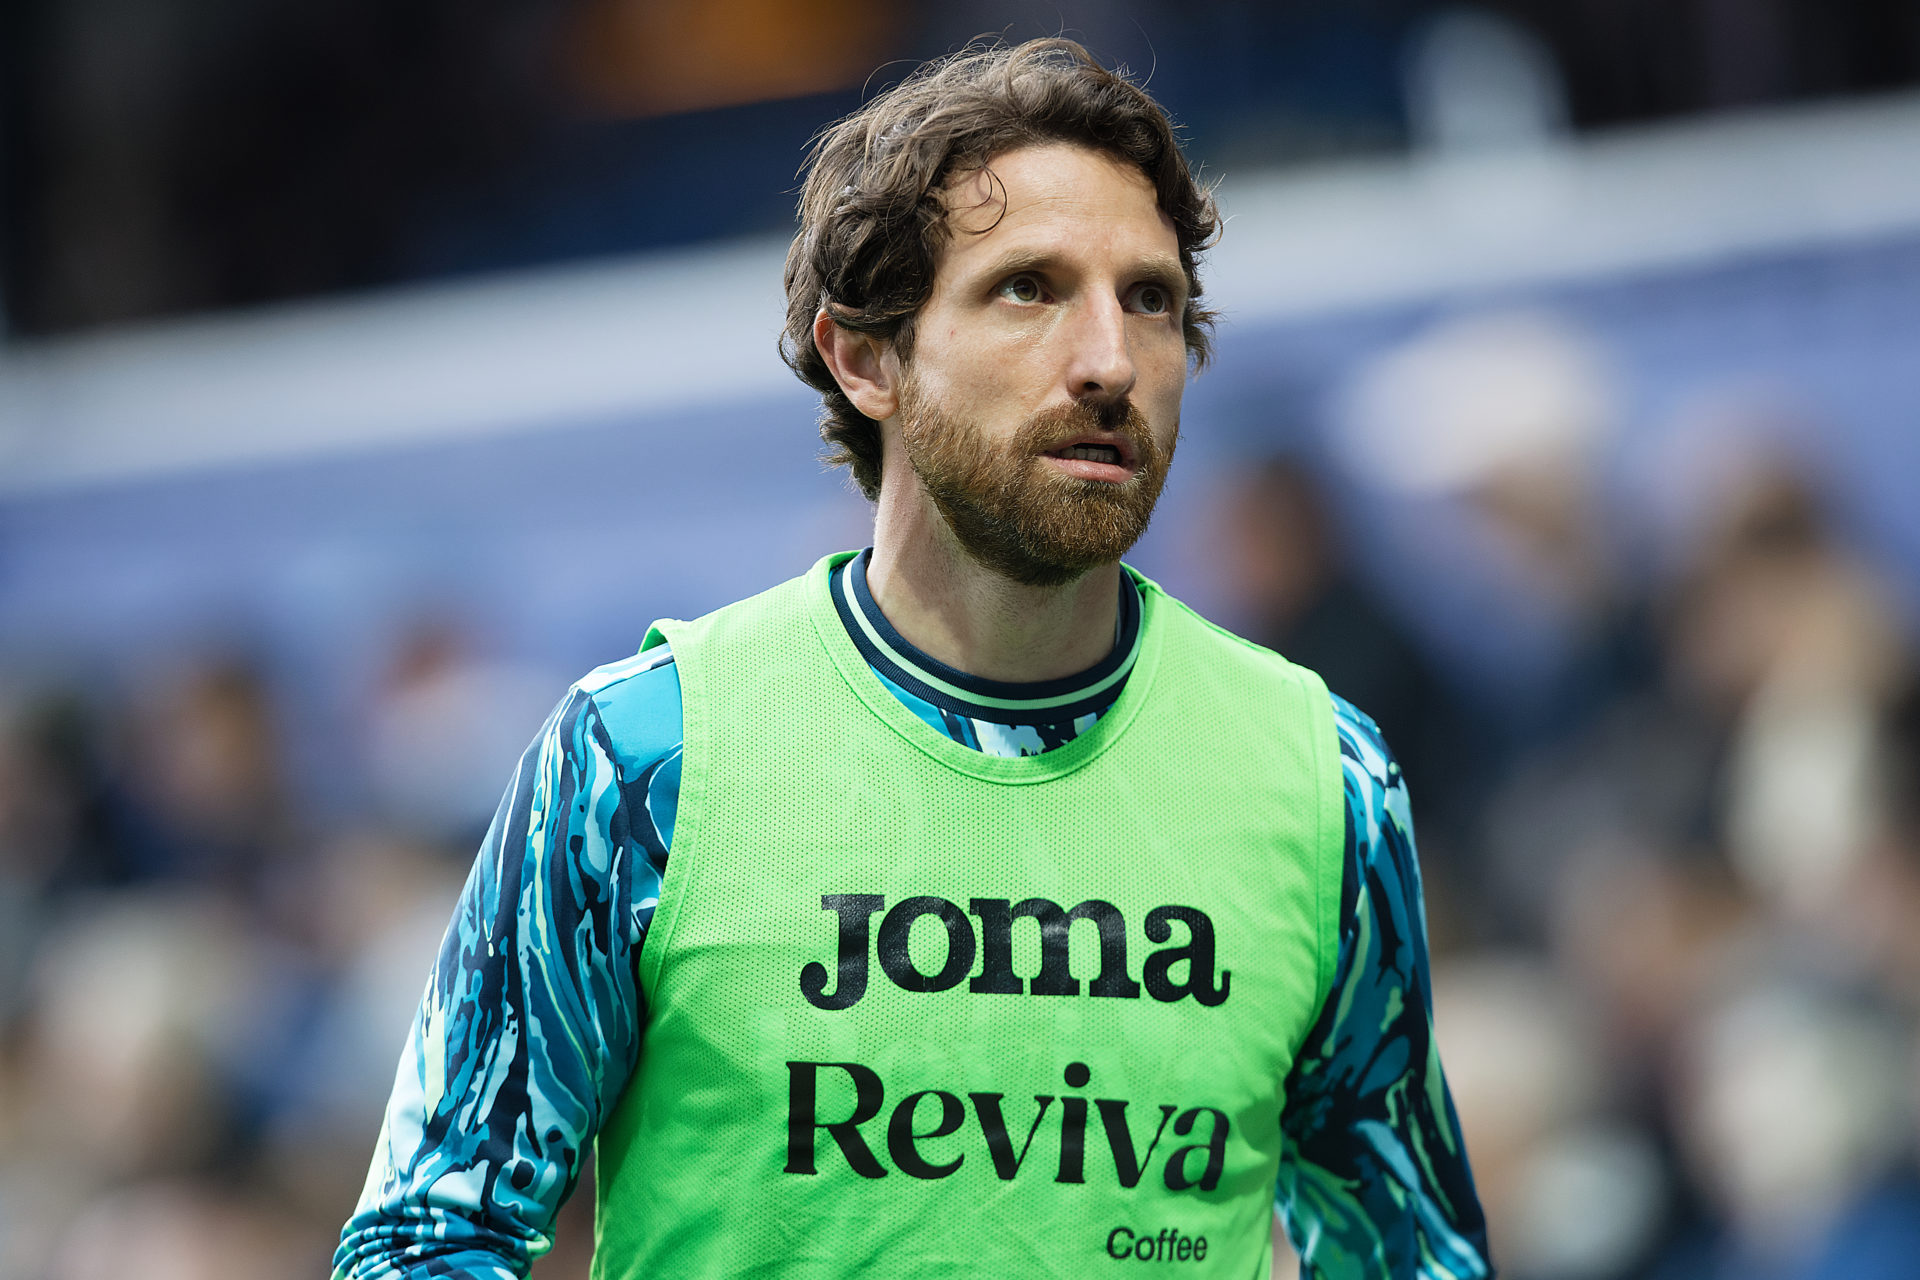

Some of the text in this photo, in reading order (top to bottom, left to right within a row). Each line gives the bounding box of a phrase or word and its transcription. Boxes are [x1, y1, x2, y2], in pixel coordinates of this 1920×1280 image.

[799, 893, 1232, 1011] Joma
[782, 1061, 1231, 1194] Reviva
[1106, 1226, 1208, 1262] Coffee
